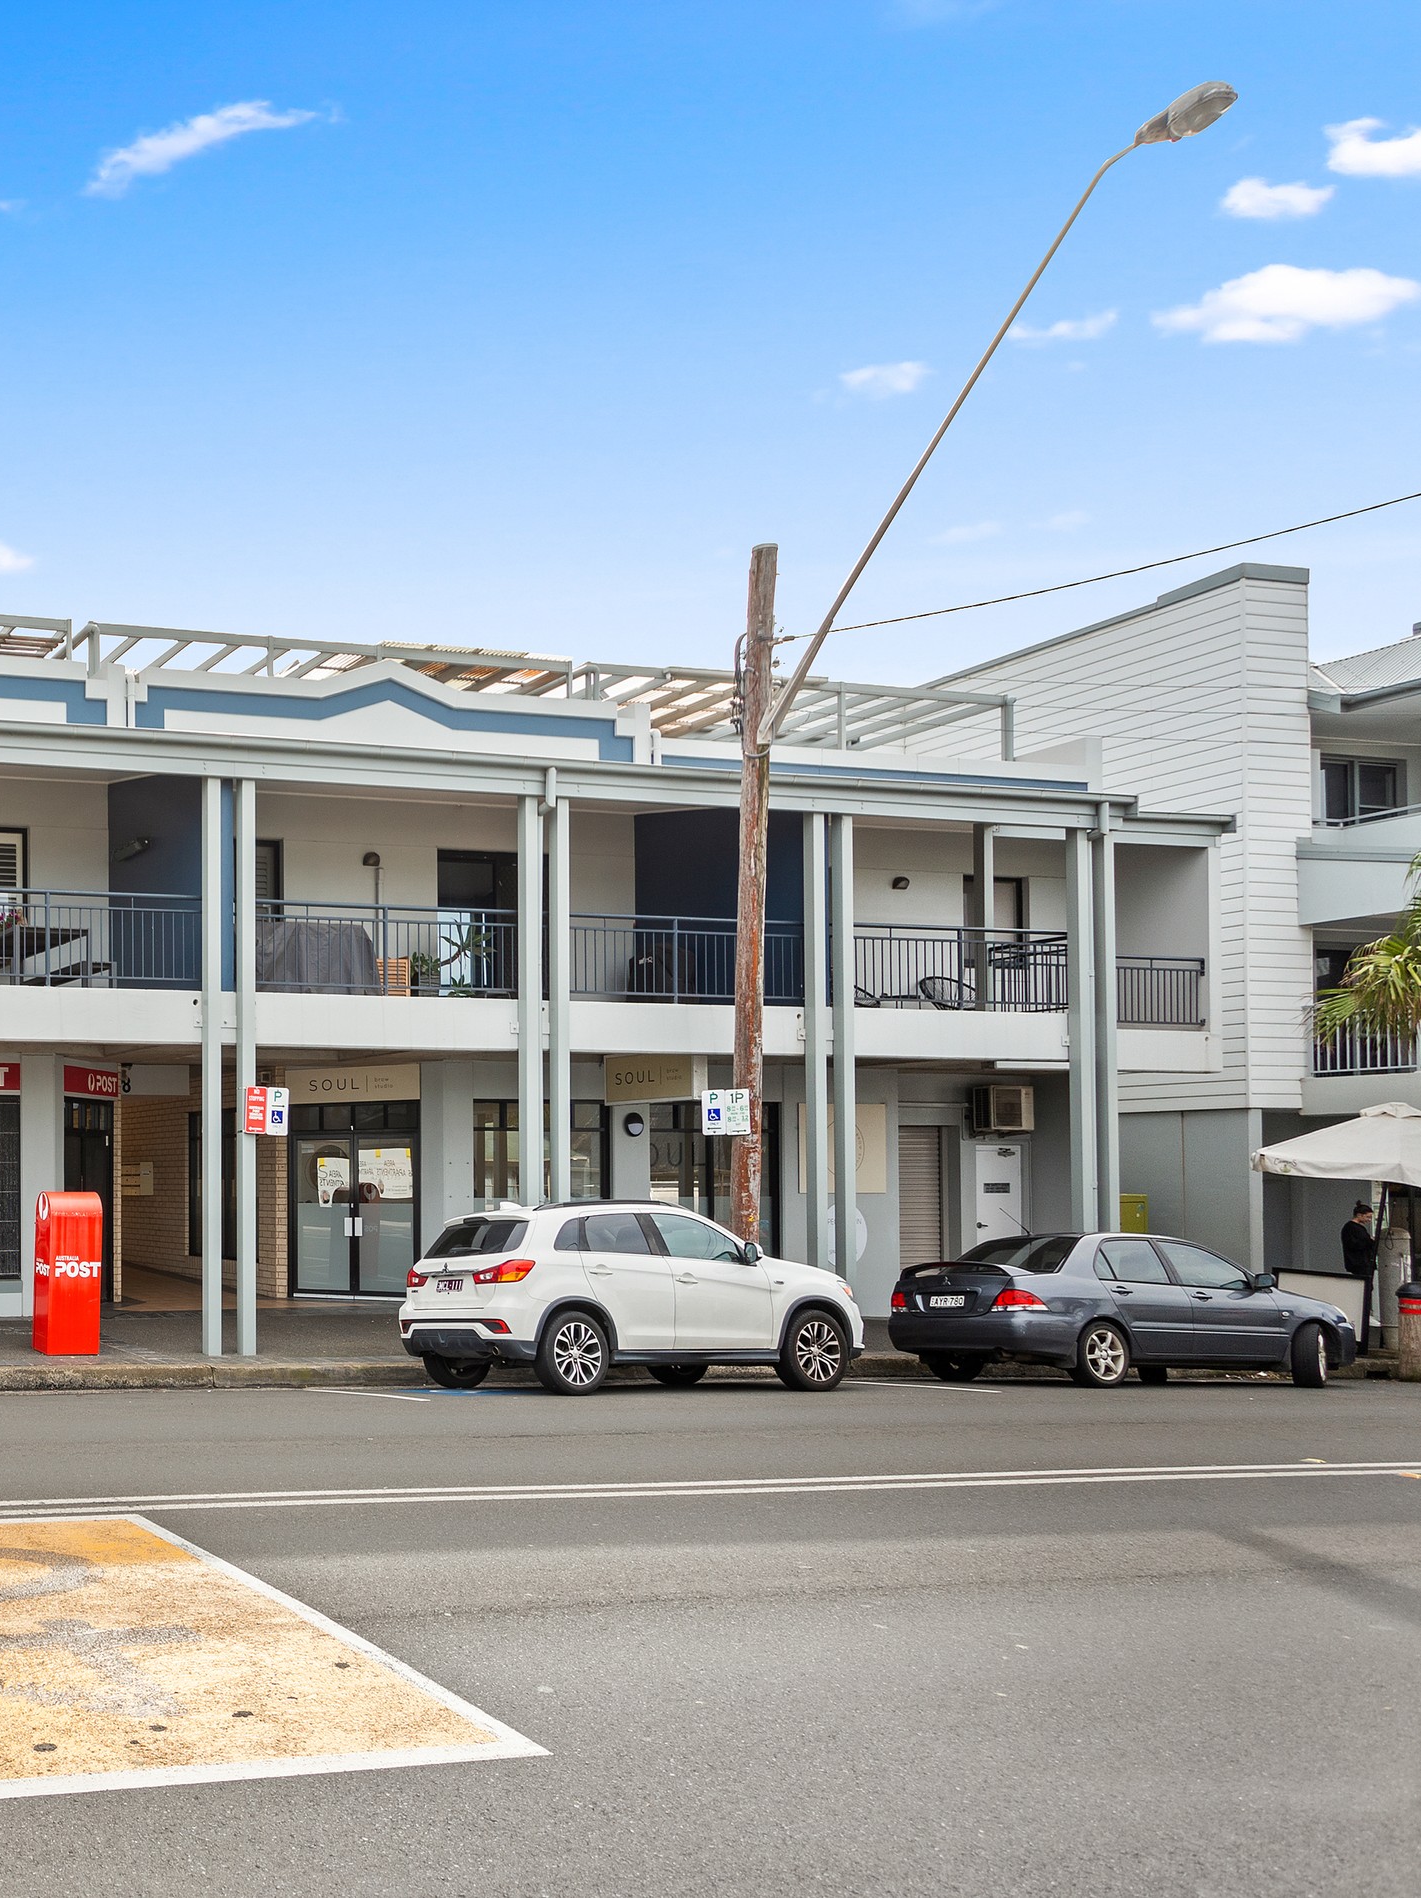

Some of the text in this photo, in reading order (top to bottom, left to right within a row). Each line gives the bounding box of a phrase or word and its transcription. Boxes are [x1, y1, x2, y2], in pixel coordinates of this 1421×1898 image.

[96, 1075, 118, 1093] POST
[309, 1078, 360, 1092] SOUL
[615, 1070, 655, 1086] SOUL
[274, 1091, 283, 1102] P
[710, 1093, 719, 1104] P
[730, 1092, 744, 1104] 1P
[35, 1261, 51, 1277] POST
[54, 1261, 102, 1278] POST
